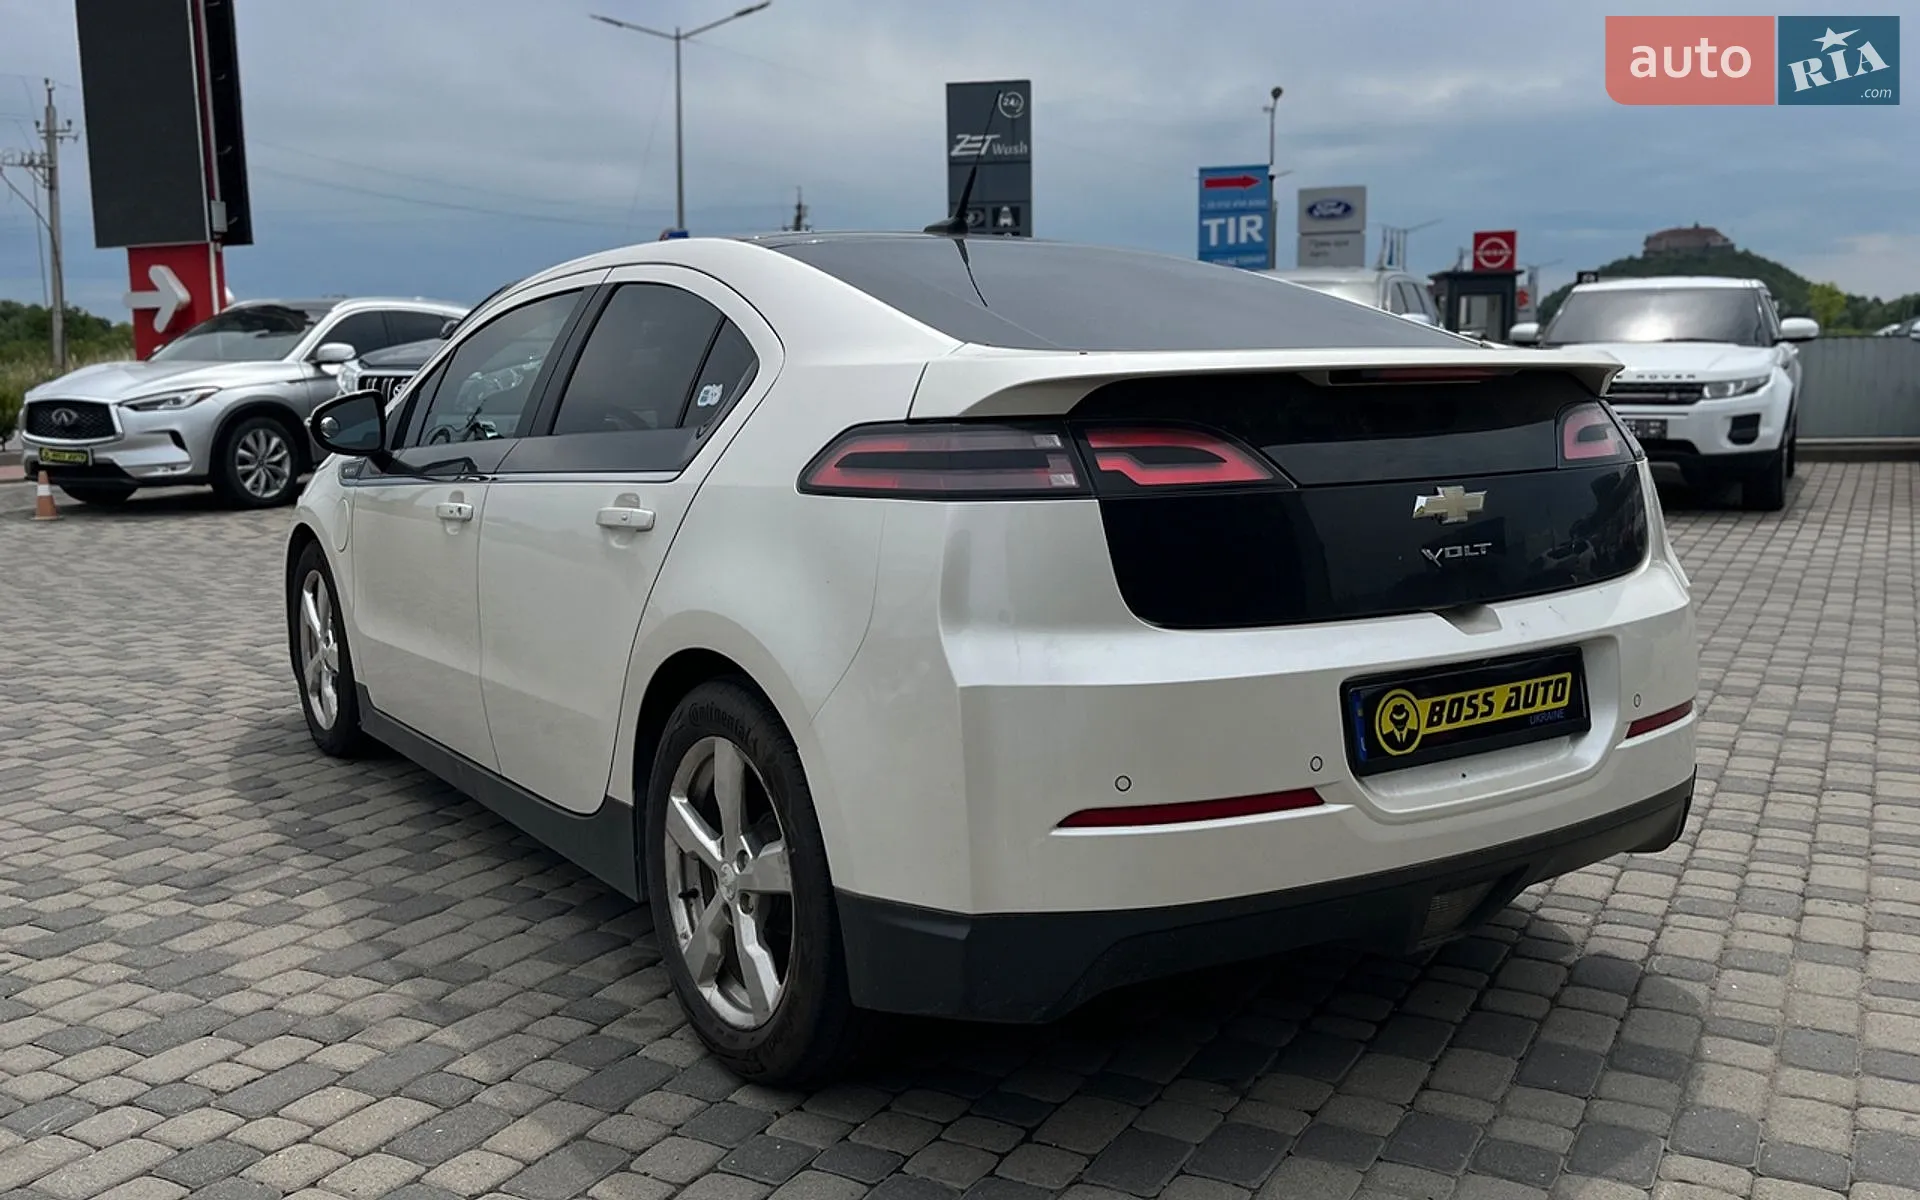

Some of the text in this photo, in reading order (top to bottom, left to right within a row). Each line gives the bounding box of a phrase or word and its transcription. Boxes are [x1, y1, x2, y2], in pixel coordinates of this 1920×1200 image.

[950, 134, 1028, 157] ZET Wash
[1202, 214, 1264, 247] TIR
[1421, 542, 1492, 567] VOLT
[1426, 677, 1568, 729] BOSS AUTO
[1530, 708, 1565, 725] UKRAINE
